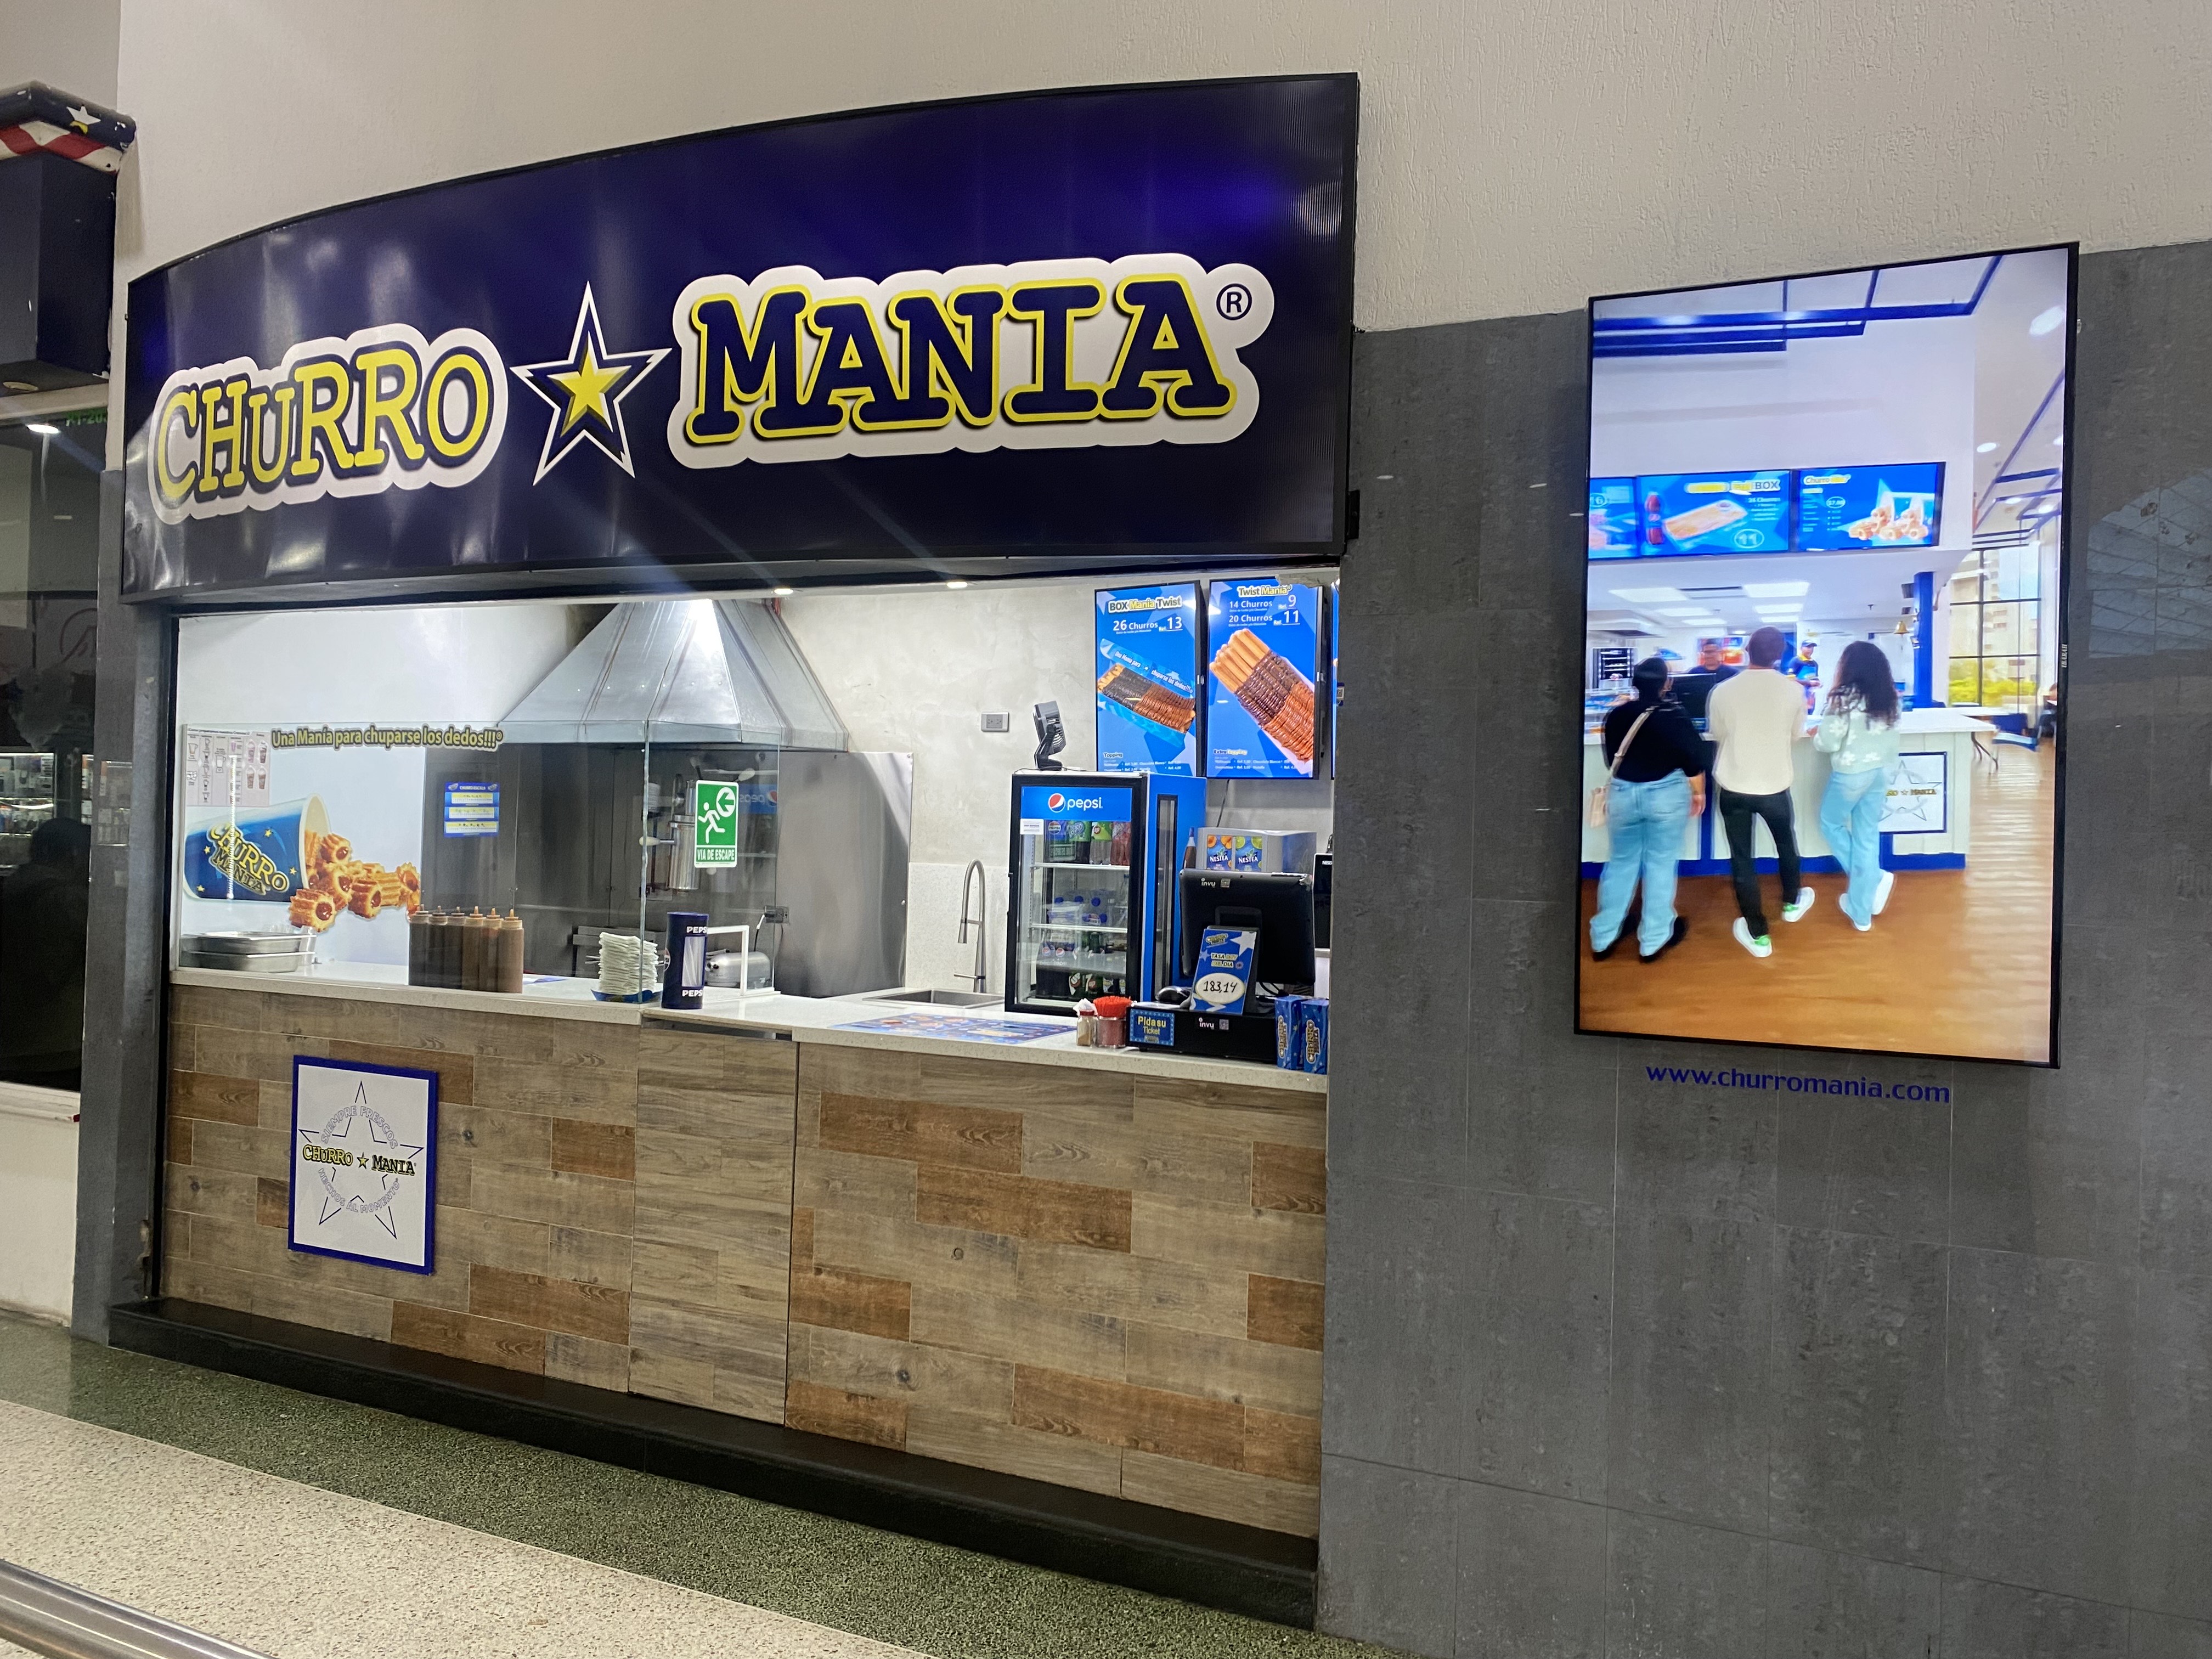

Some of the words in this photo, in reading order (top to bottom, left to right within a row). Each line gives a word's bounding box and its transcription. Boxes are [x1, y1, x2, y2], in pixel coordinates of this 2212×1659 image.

[156, 343, 492, 506] CHURRO
[1238, 586, 1260, 596] Twist
[1109, 601, 1128, 611] BOX
[1156, 596, 1181, 607] Twist
[1288, 594, 1296, 607] 9
[1113, 619, 1127, 631] 26
[1128, 622, 1158, 630] Churros
[1167, 616, 1182, 629] 13
[1284, 610, 1299, 623] 11
[272, 730, 295, 747] Una
[335, 731, 362, 750] para
[364, 725, 421, 750] chuparse
[422, 726, 442, 746] los
[1066, 797, 1102, 811] pepsi
[697, 849, 706, 860] VIA
[707, 849, 714, 860] DE
[715, 849, 735, 861] ESCAPE
[1238, 856, 1259, 864] NESTEA
[681, 989, 703, 997] PEPS
[1203, 980, 1238, 994] 183,14
[1143, 1025, 1160, 1035] Ticket
[1646, 1066, 1950, 1103] www.churromania.com
[320, 1105, 357, 1144] SIEMPRE
[360, 1105, 398, 1149] FRESCOS
[302, 1144, 353, 1166] CHURRO
[371, 1154, 415, 1176] MANIA
[318, 1167, 346, 1206] HECHOS
[346, 1201, 358, 1213] AL
[360, 1180, 400, 1214] MOMENTO
